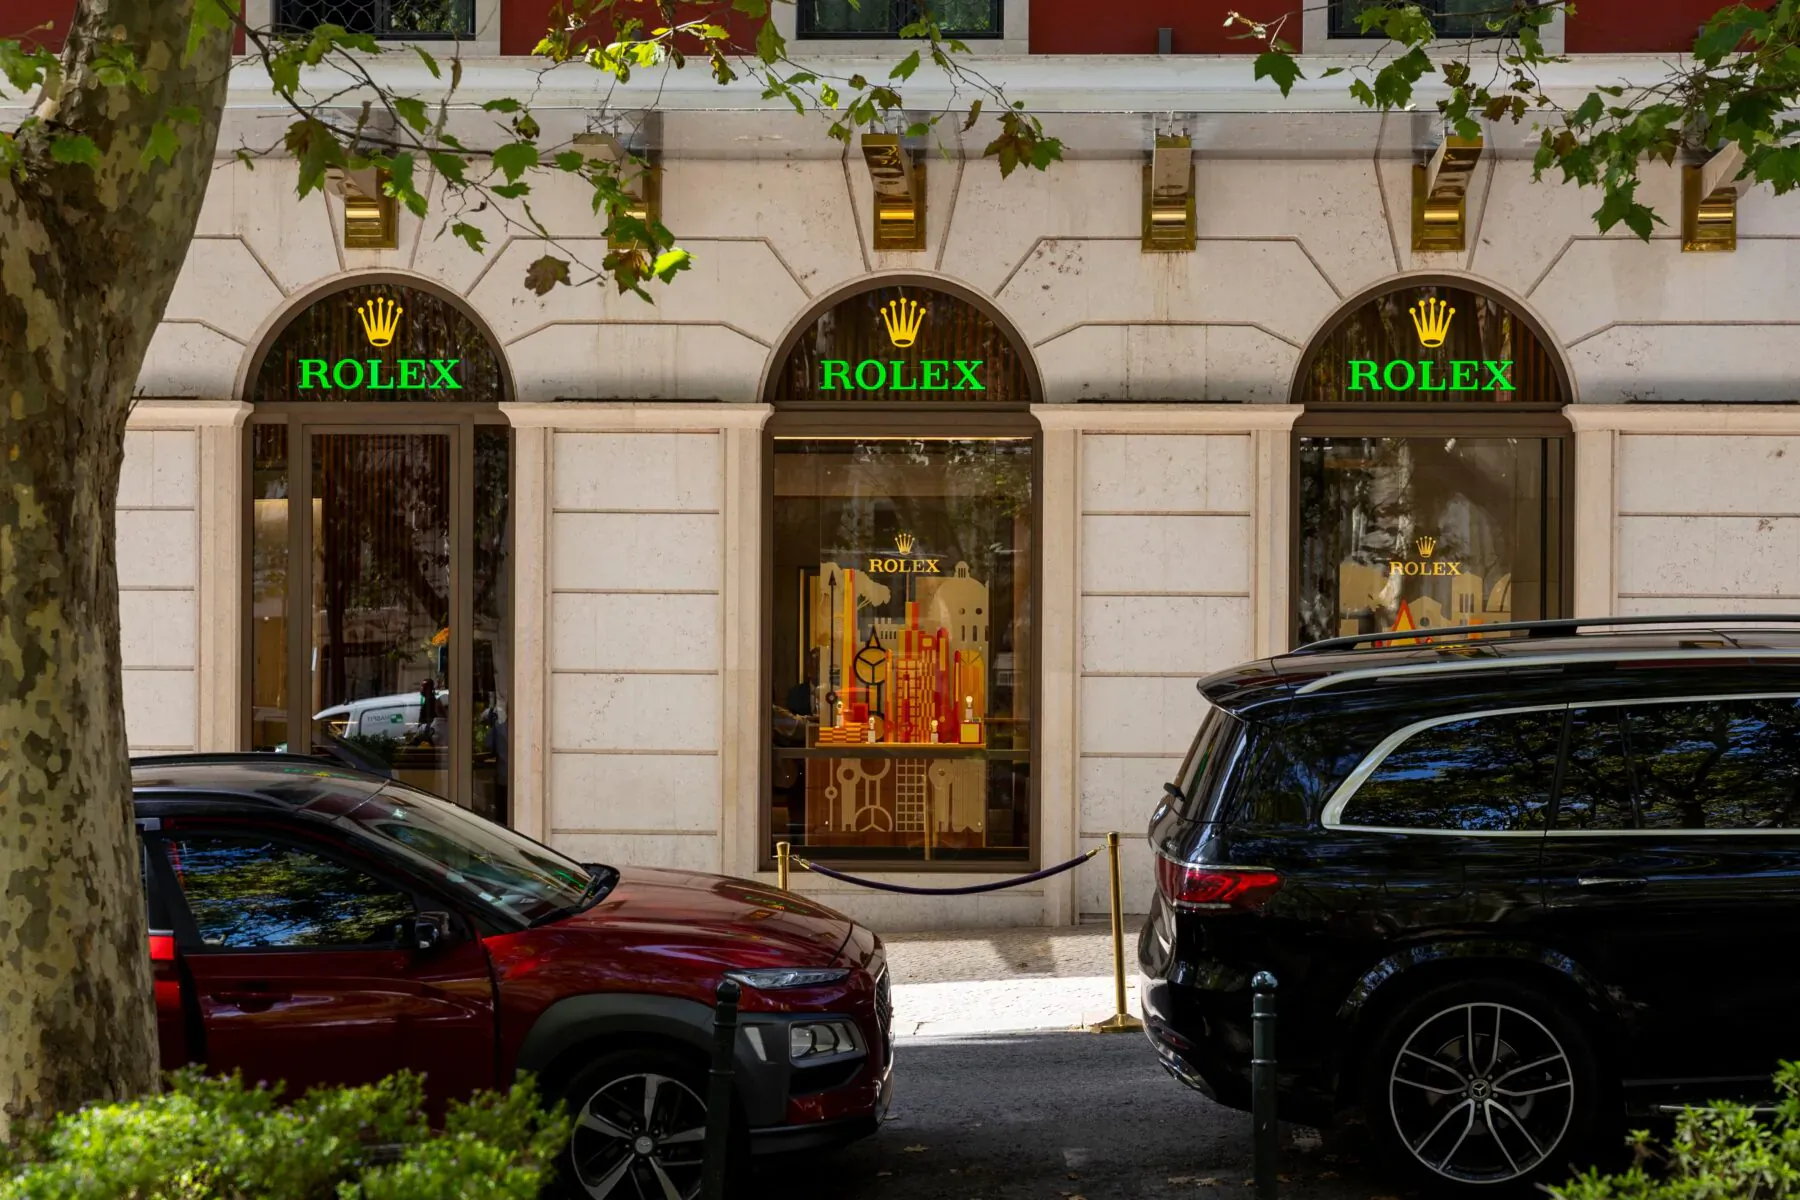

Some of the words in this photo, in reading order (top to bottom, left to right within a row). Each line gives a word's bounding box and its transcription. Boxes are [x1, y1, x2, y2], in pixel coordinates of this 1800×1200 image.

[299, 359, 462, 390] ROLEX
[820, 359, 985, 391] ROLEX
[1347, 359, 1516, 391] ROLEX
[869, 559, 940, 573] ROLEX
[1389, 562, 1461, 576] ROLEX
